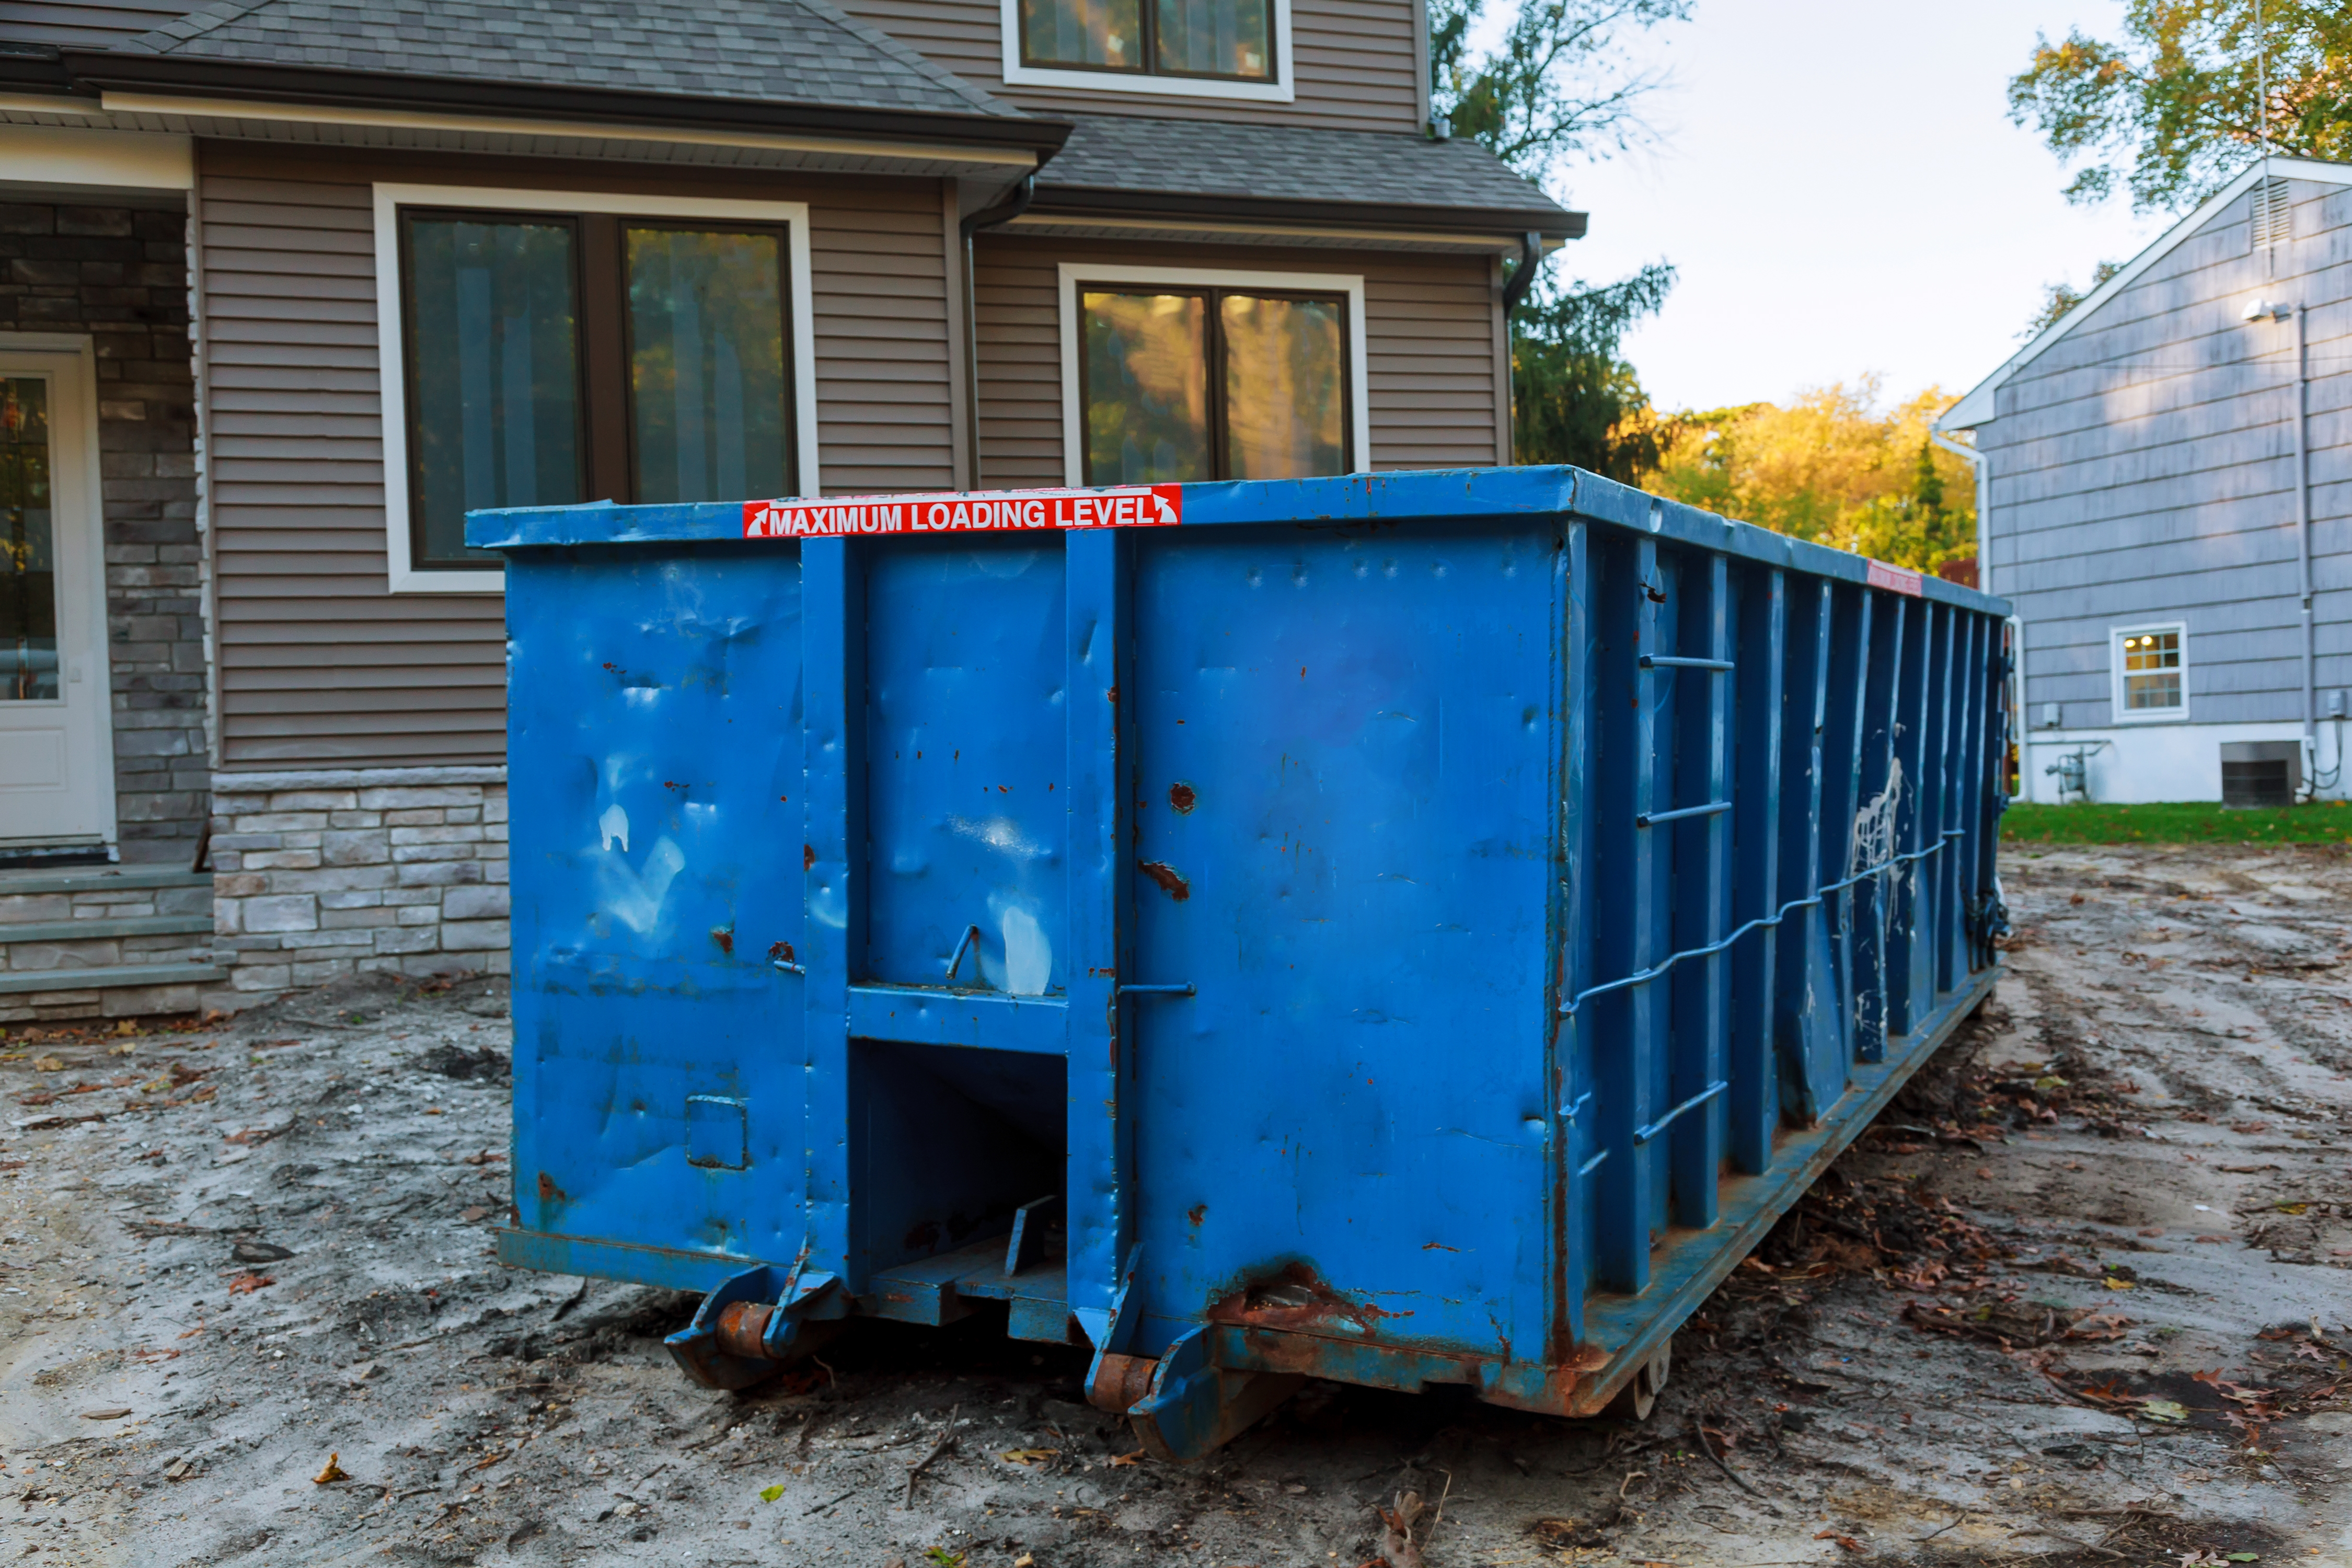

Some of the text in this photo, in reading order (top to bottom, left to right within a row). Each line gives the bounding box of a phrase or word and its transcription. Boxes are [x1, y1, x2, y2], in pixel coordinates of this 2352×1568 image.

[769, 497, 1154, 535] MAXIMUM LOADING LEVEL
